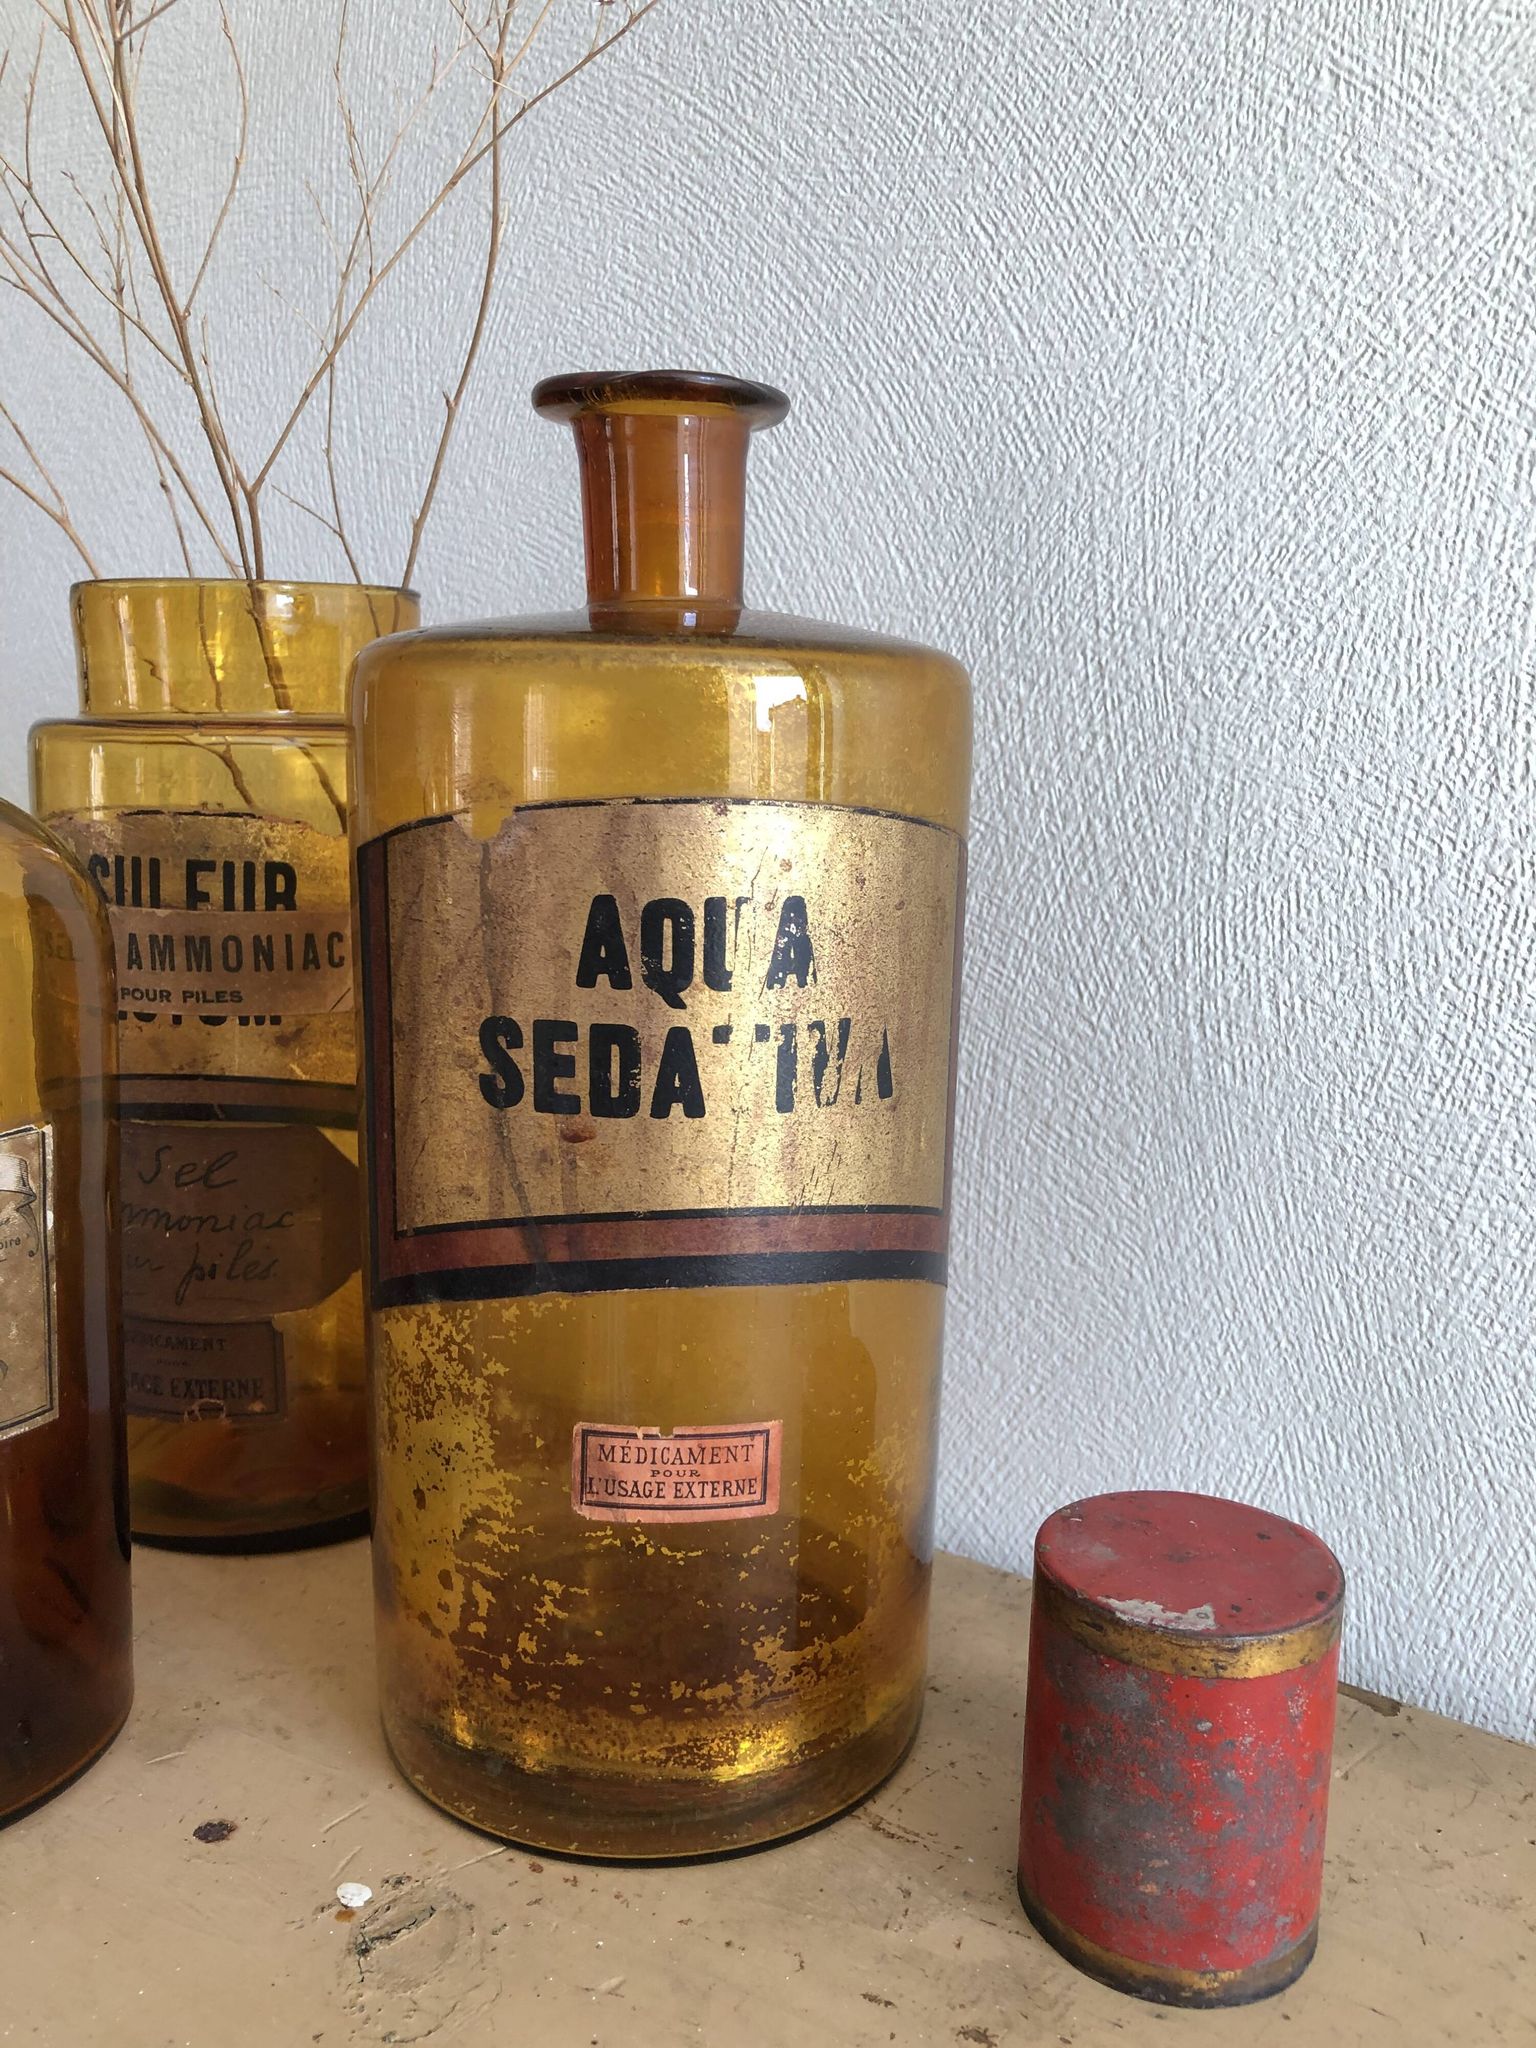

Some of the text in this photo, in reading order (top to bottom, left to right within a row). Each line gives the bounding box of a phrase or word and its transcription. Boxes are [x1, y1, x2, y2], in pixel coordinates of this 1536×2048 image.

[126, 931, 345, 973] AMMONIAC
[576, 894, 817, 1009] AQUA
[120, 986, 243, 1004] POUR PILES
[478, 1015, 893, 1119] SEDAIVA
[138, 1145, 239, 1189] Sel
[597, 1441, 755, 1466] MÉDICAMENT
[586, 1477, 758, 1499] L'USAGE EXTERNE
[650, 1469, 701, 1478] POUR
